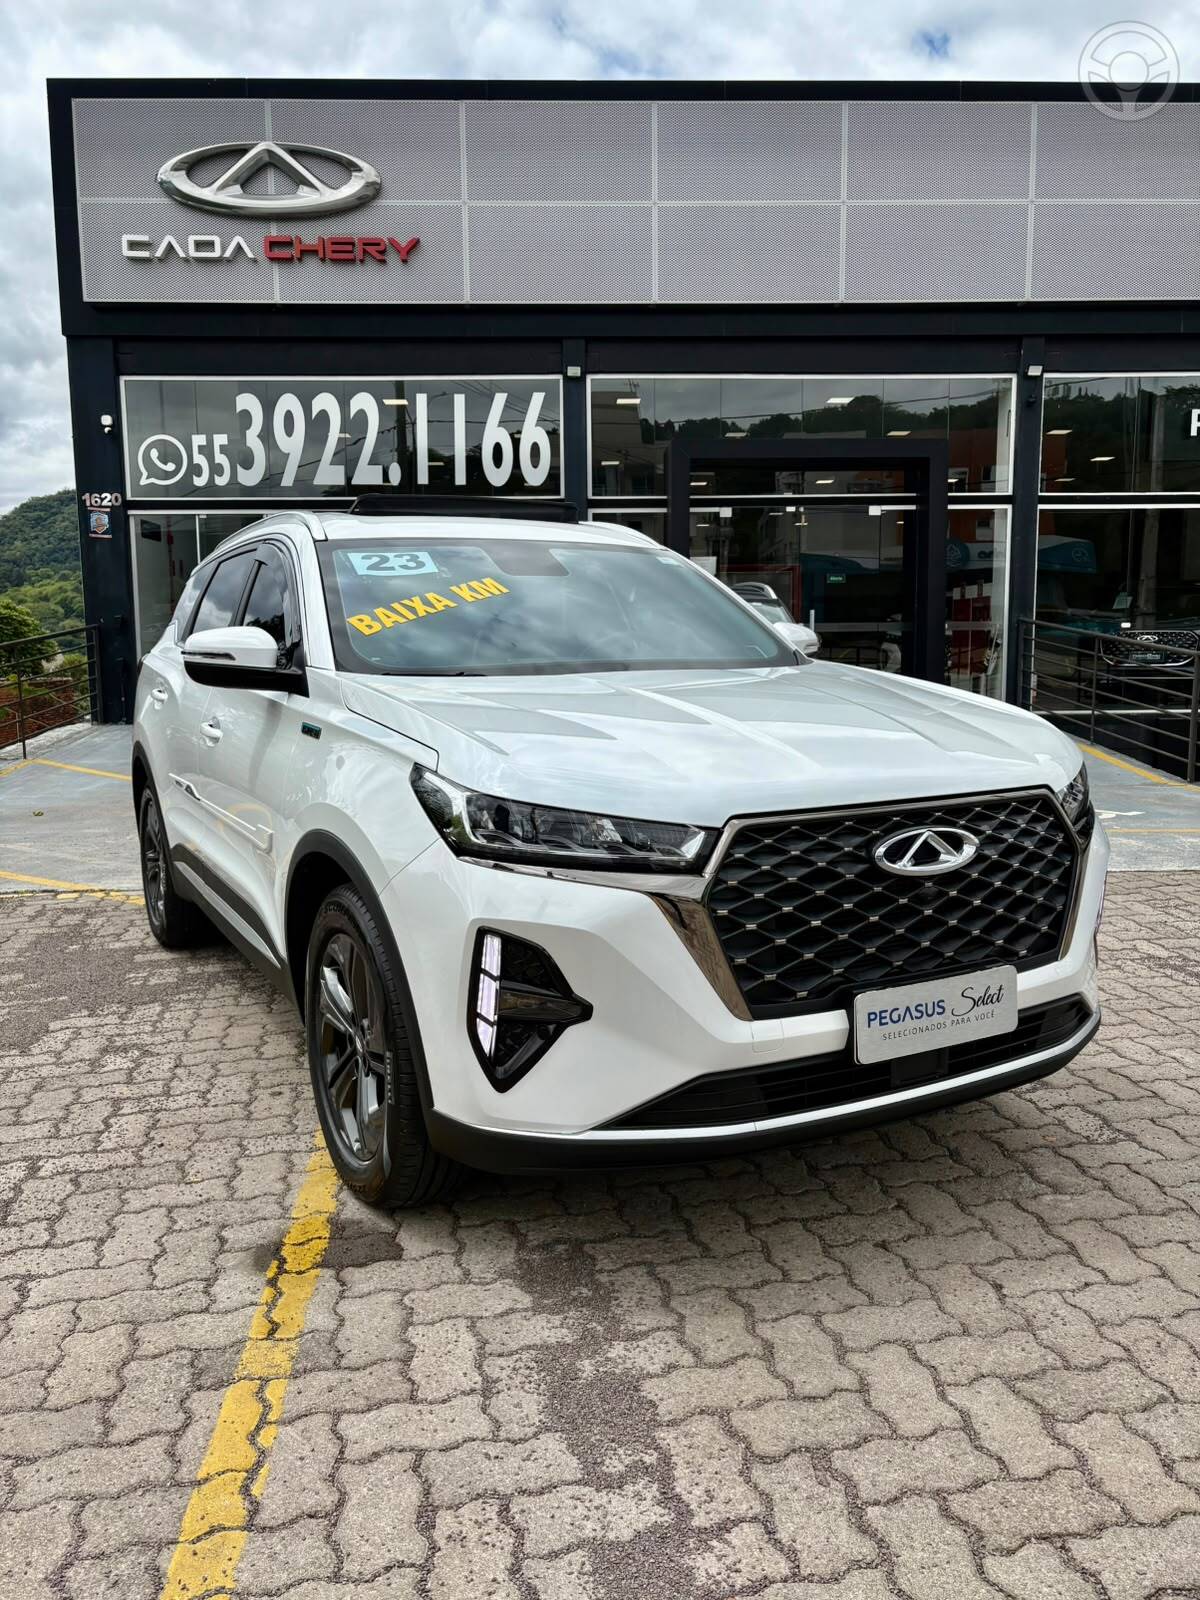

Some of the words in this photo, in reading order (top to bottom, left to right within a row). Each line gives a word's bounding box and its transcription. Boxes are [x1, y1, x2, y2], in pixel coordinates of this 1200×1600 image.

[121, 234, 256, 260] CAOA
[263, 235, 420, 263] CHERY
[191, 434, 231, 487] 55
[235, 392, 551, 487] 3922.1166
[82, 493, 122, 507] 1620
[361, 554, 426, 571] 23
[346, 592, 458, 637] BAIXA
[450, 577, 511, 602] KM
[867, 999, 946, 1029] PEGASUS
[951, 984, 1004, 1017] Select
[882, 1022, 948, 1041] SELECIONADOS
[951, 1016, 971, 1027] PARA
